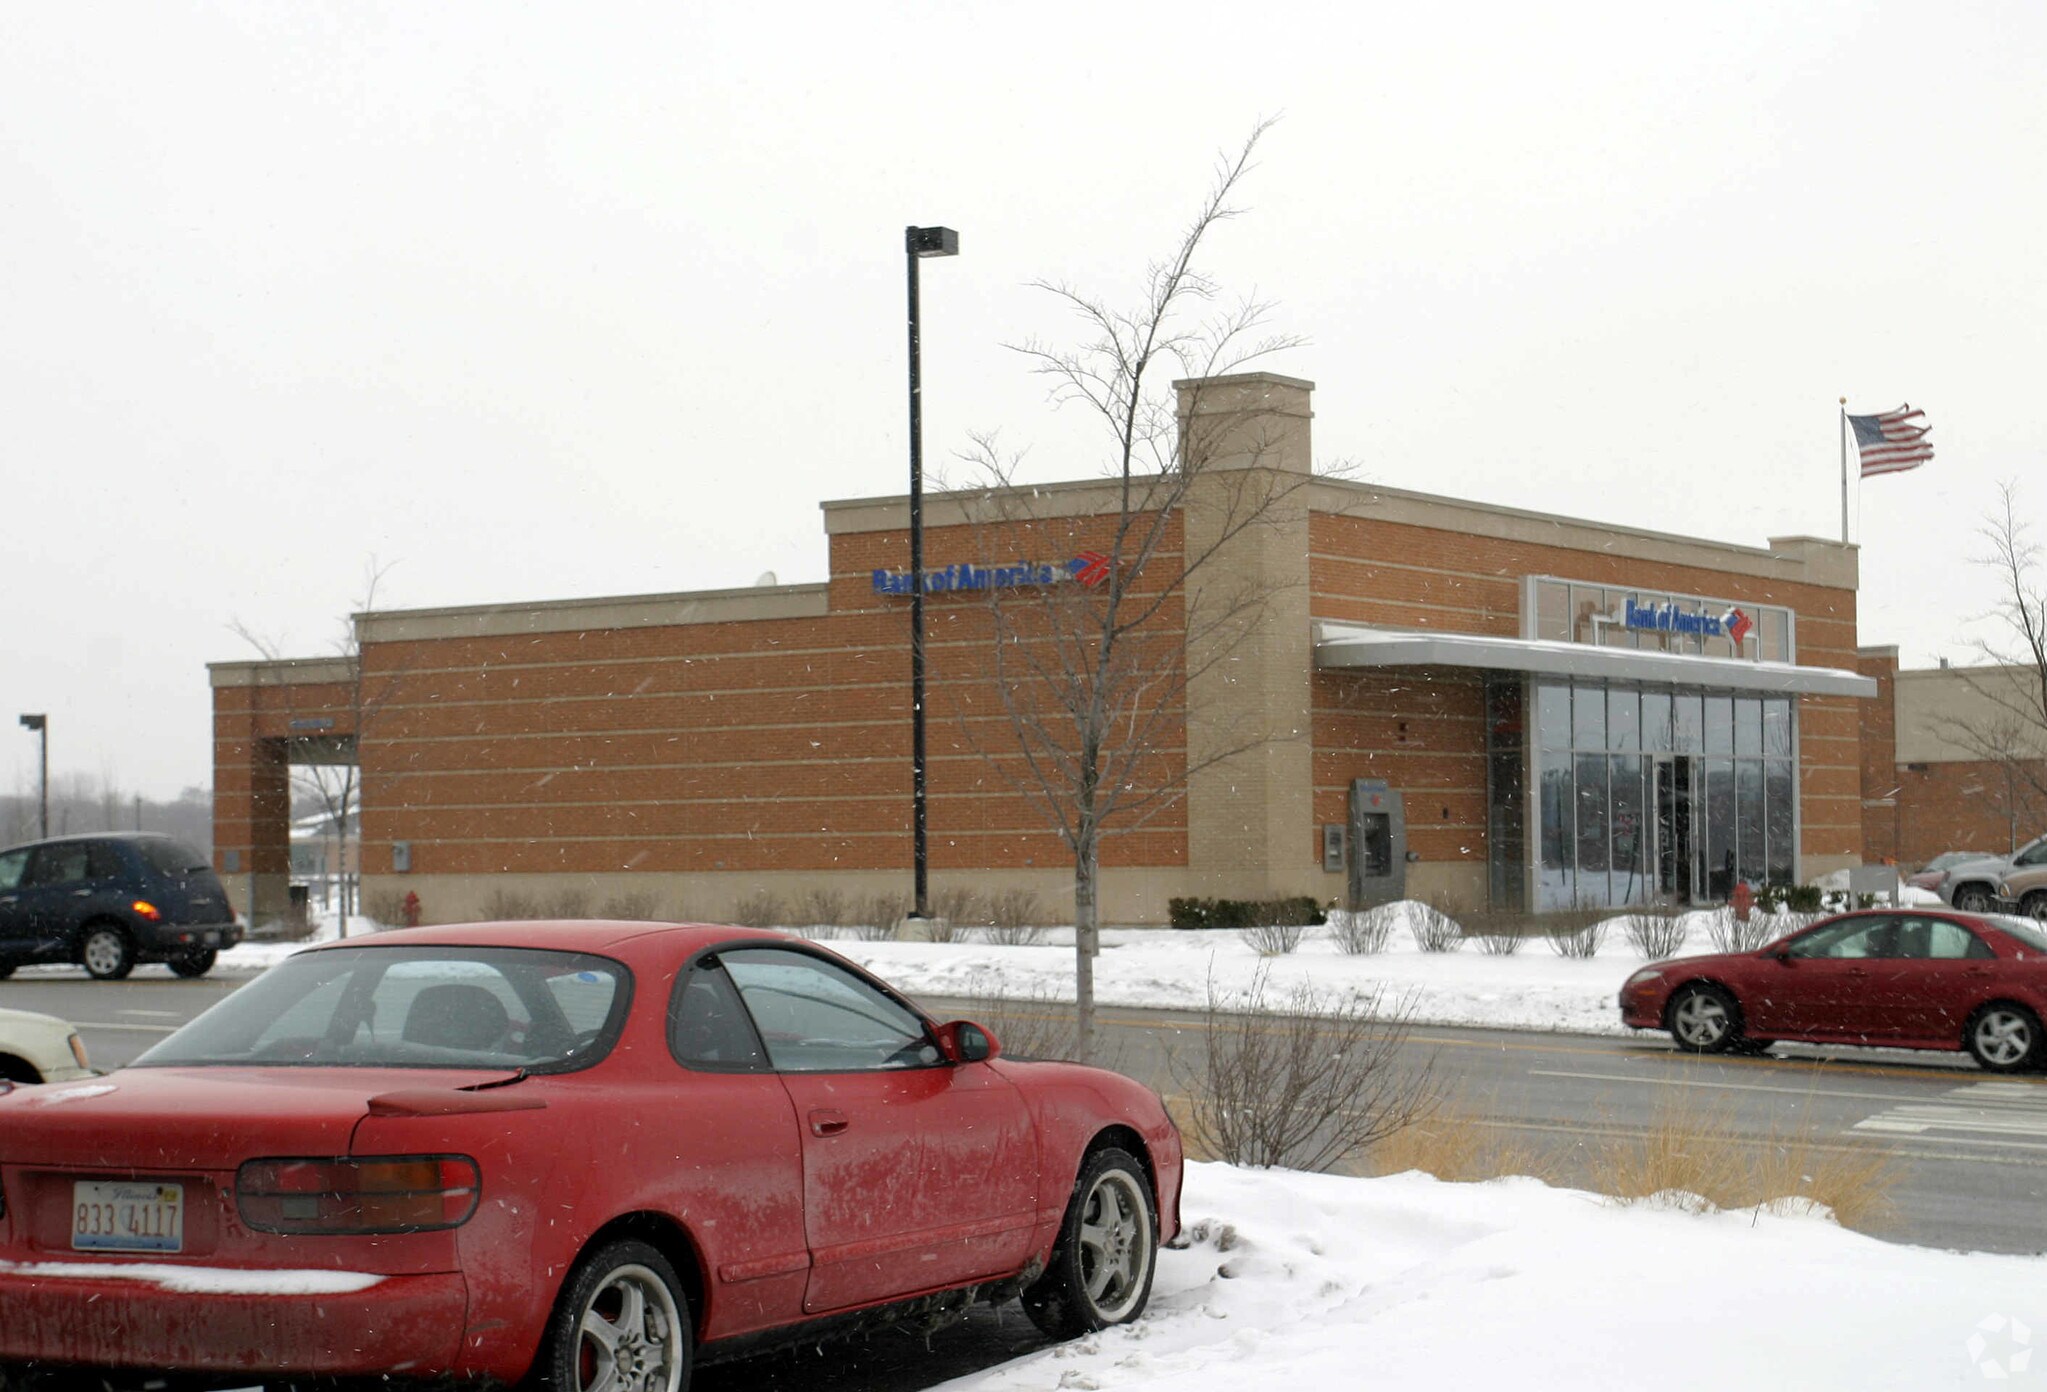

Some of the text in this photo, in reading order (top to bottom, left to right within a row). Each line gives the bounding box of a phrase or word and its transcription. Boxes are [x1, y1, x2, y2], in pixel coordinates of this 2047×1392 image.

[931, 564, 956, 592] of
[957, 560, 1054, 590] America
[1626, 599, 1721, 637] Bank of America
[77, 1203, 177, 1237] 833 4117
